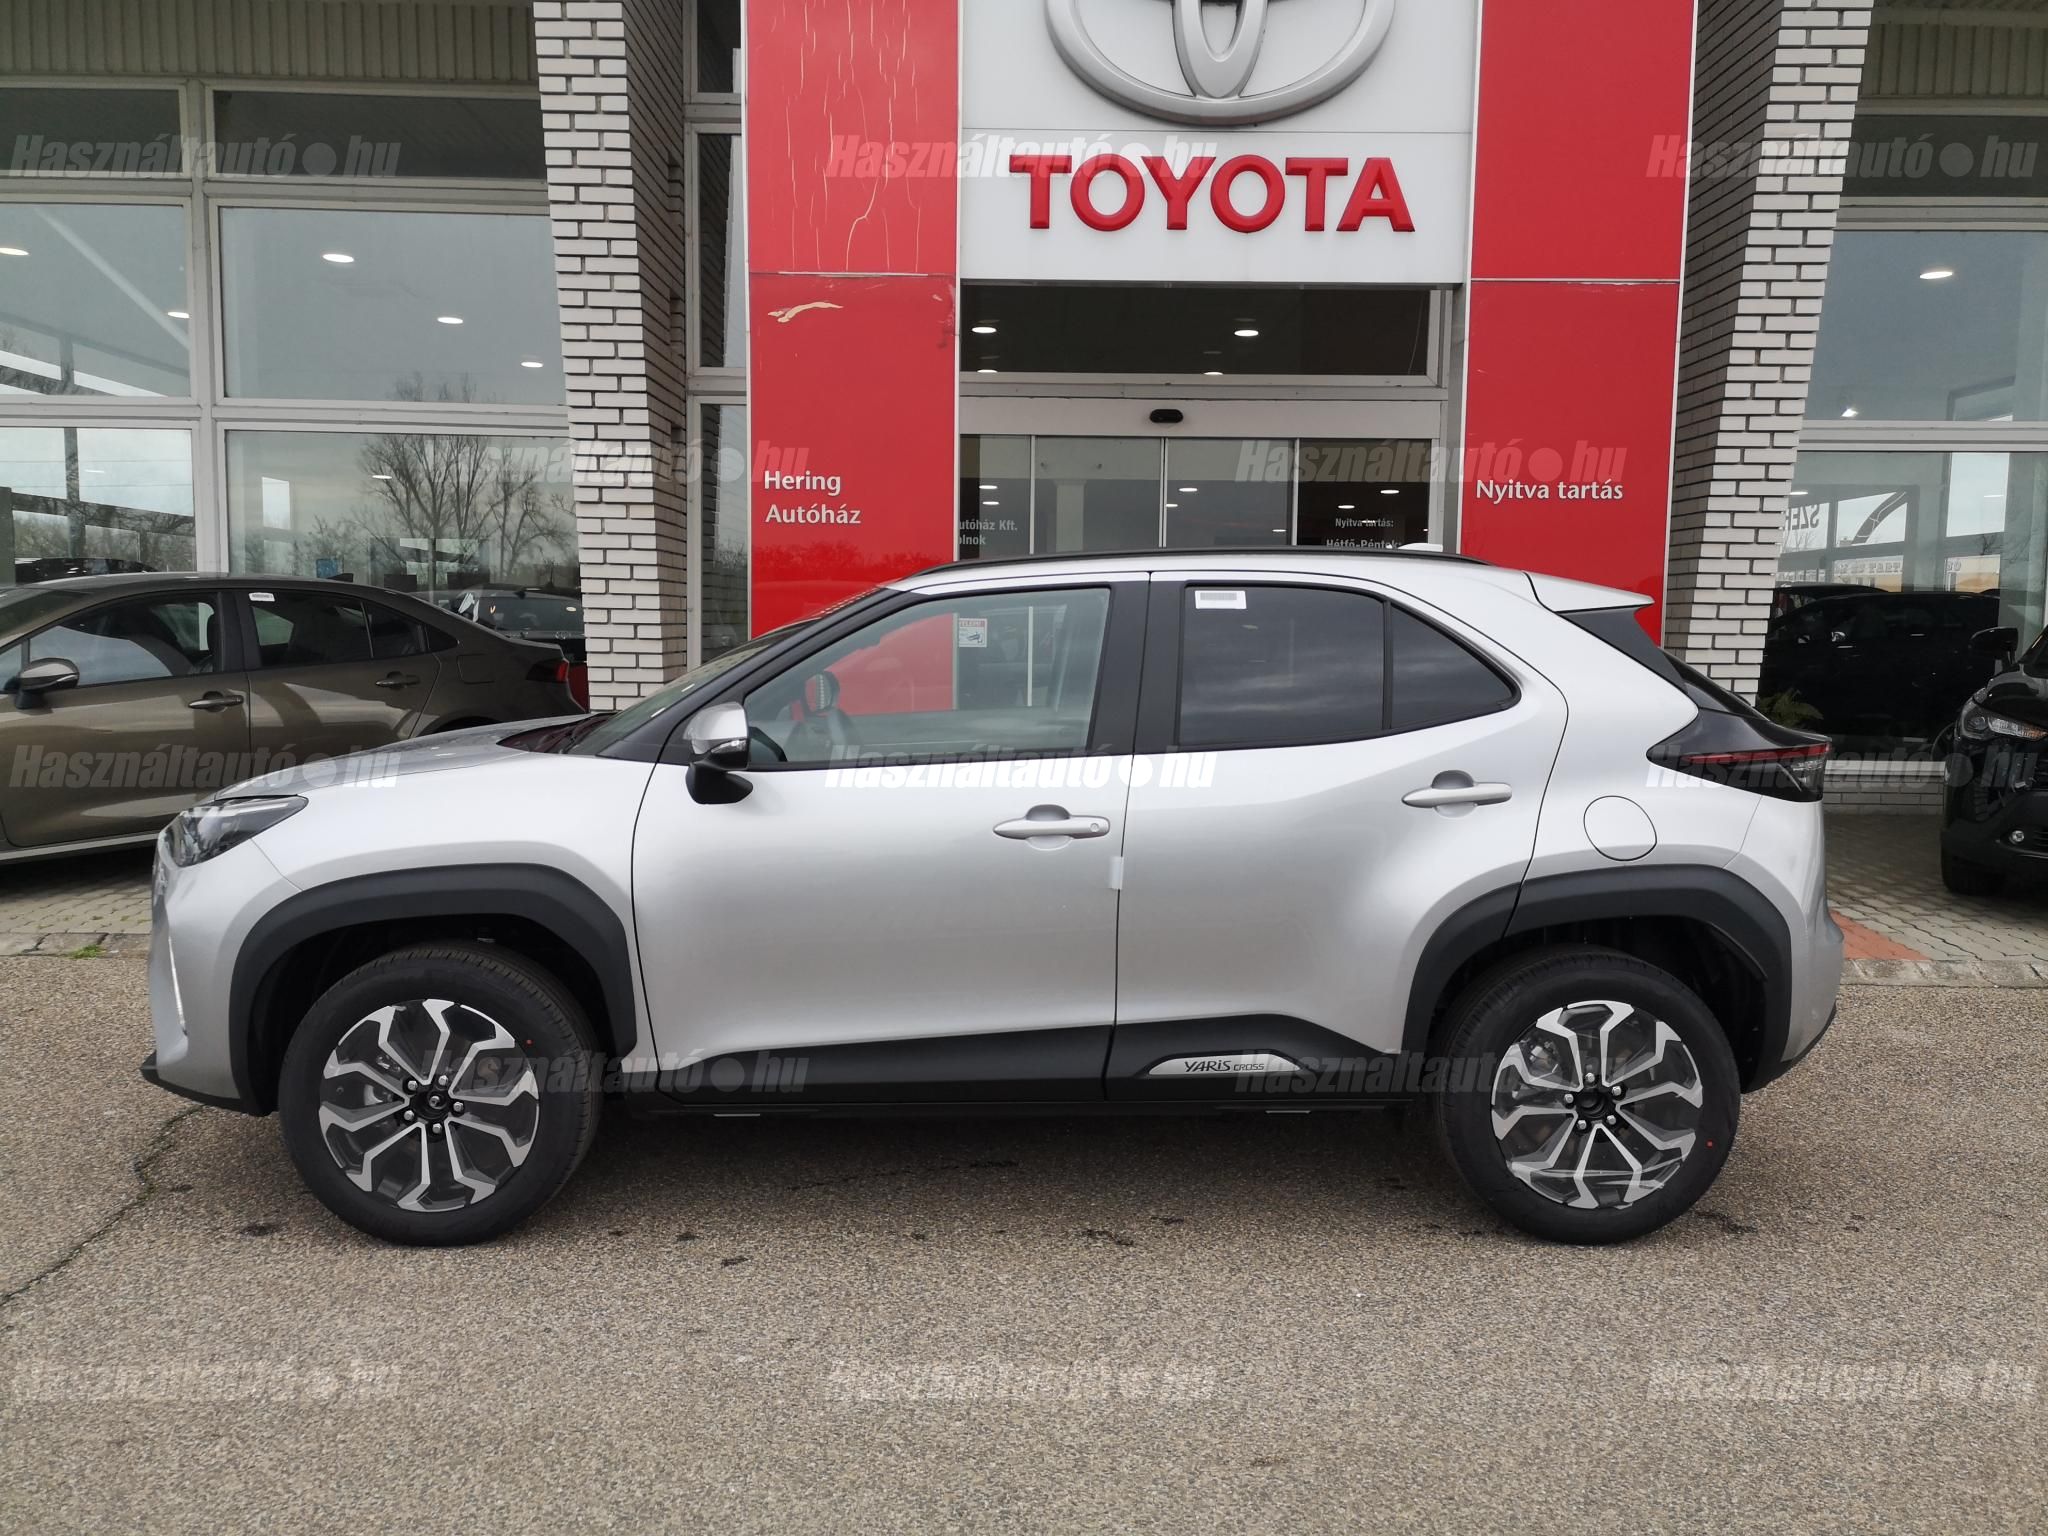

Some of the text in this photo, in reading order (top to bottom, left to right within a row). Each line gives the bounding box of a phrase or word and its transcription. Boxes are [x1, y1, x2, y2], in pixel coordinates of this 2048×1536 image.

[1009, 153, 1416, 233] TOYOTA
[764, 470, 842, 497] Hering
[1476, 478, 1624, 504] Nyitva tartás
[765, 503, 862, 525] Autóház
[959, 518, 1018, 531] utóház Kft.
[1335, 517, 1363, 529] Nyitva
[1233, 1063, 1265, 1072] CROSS
